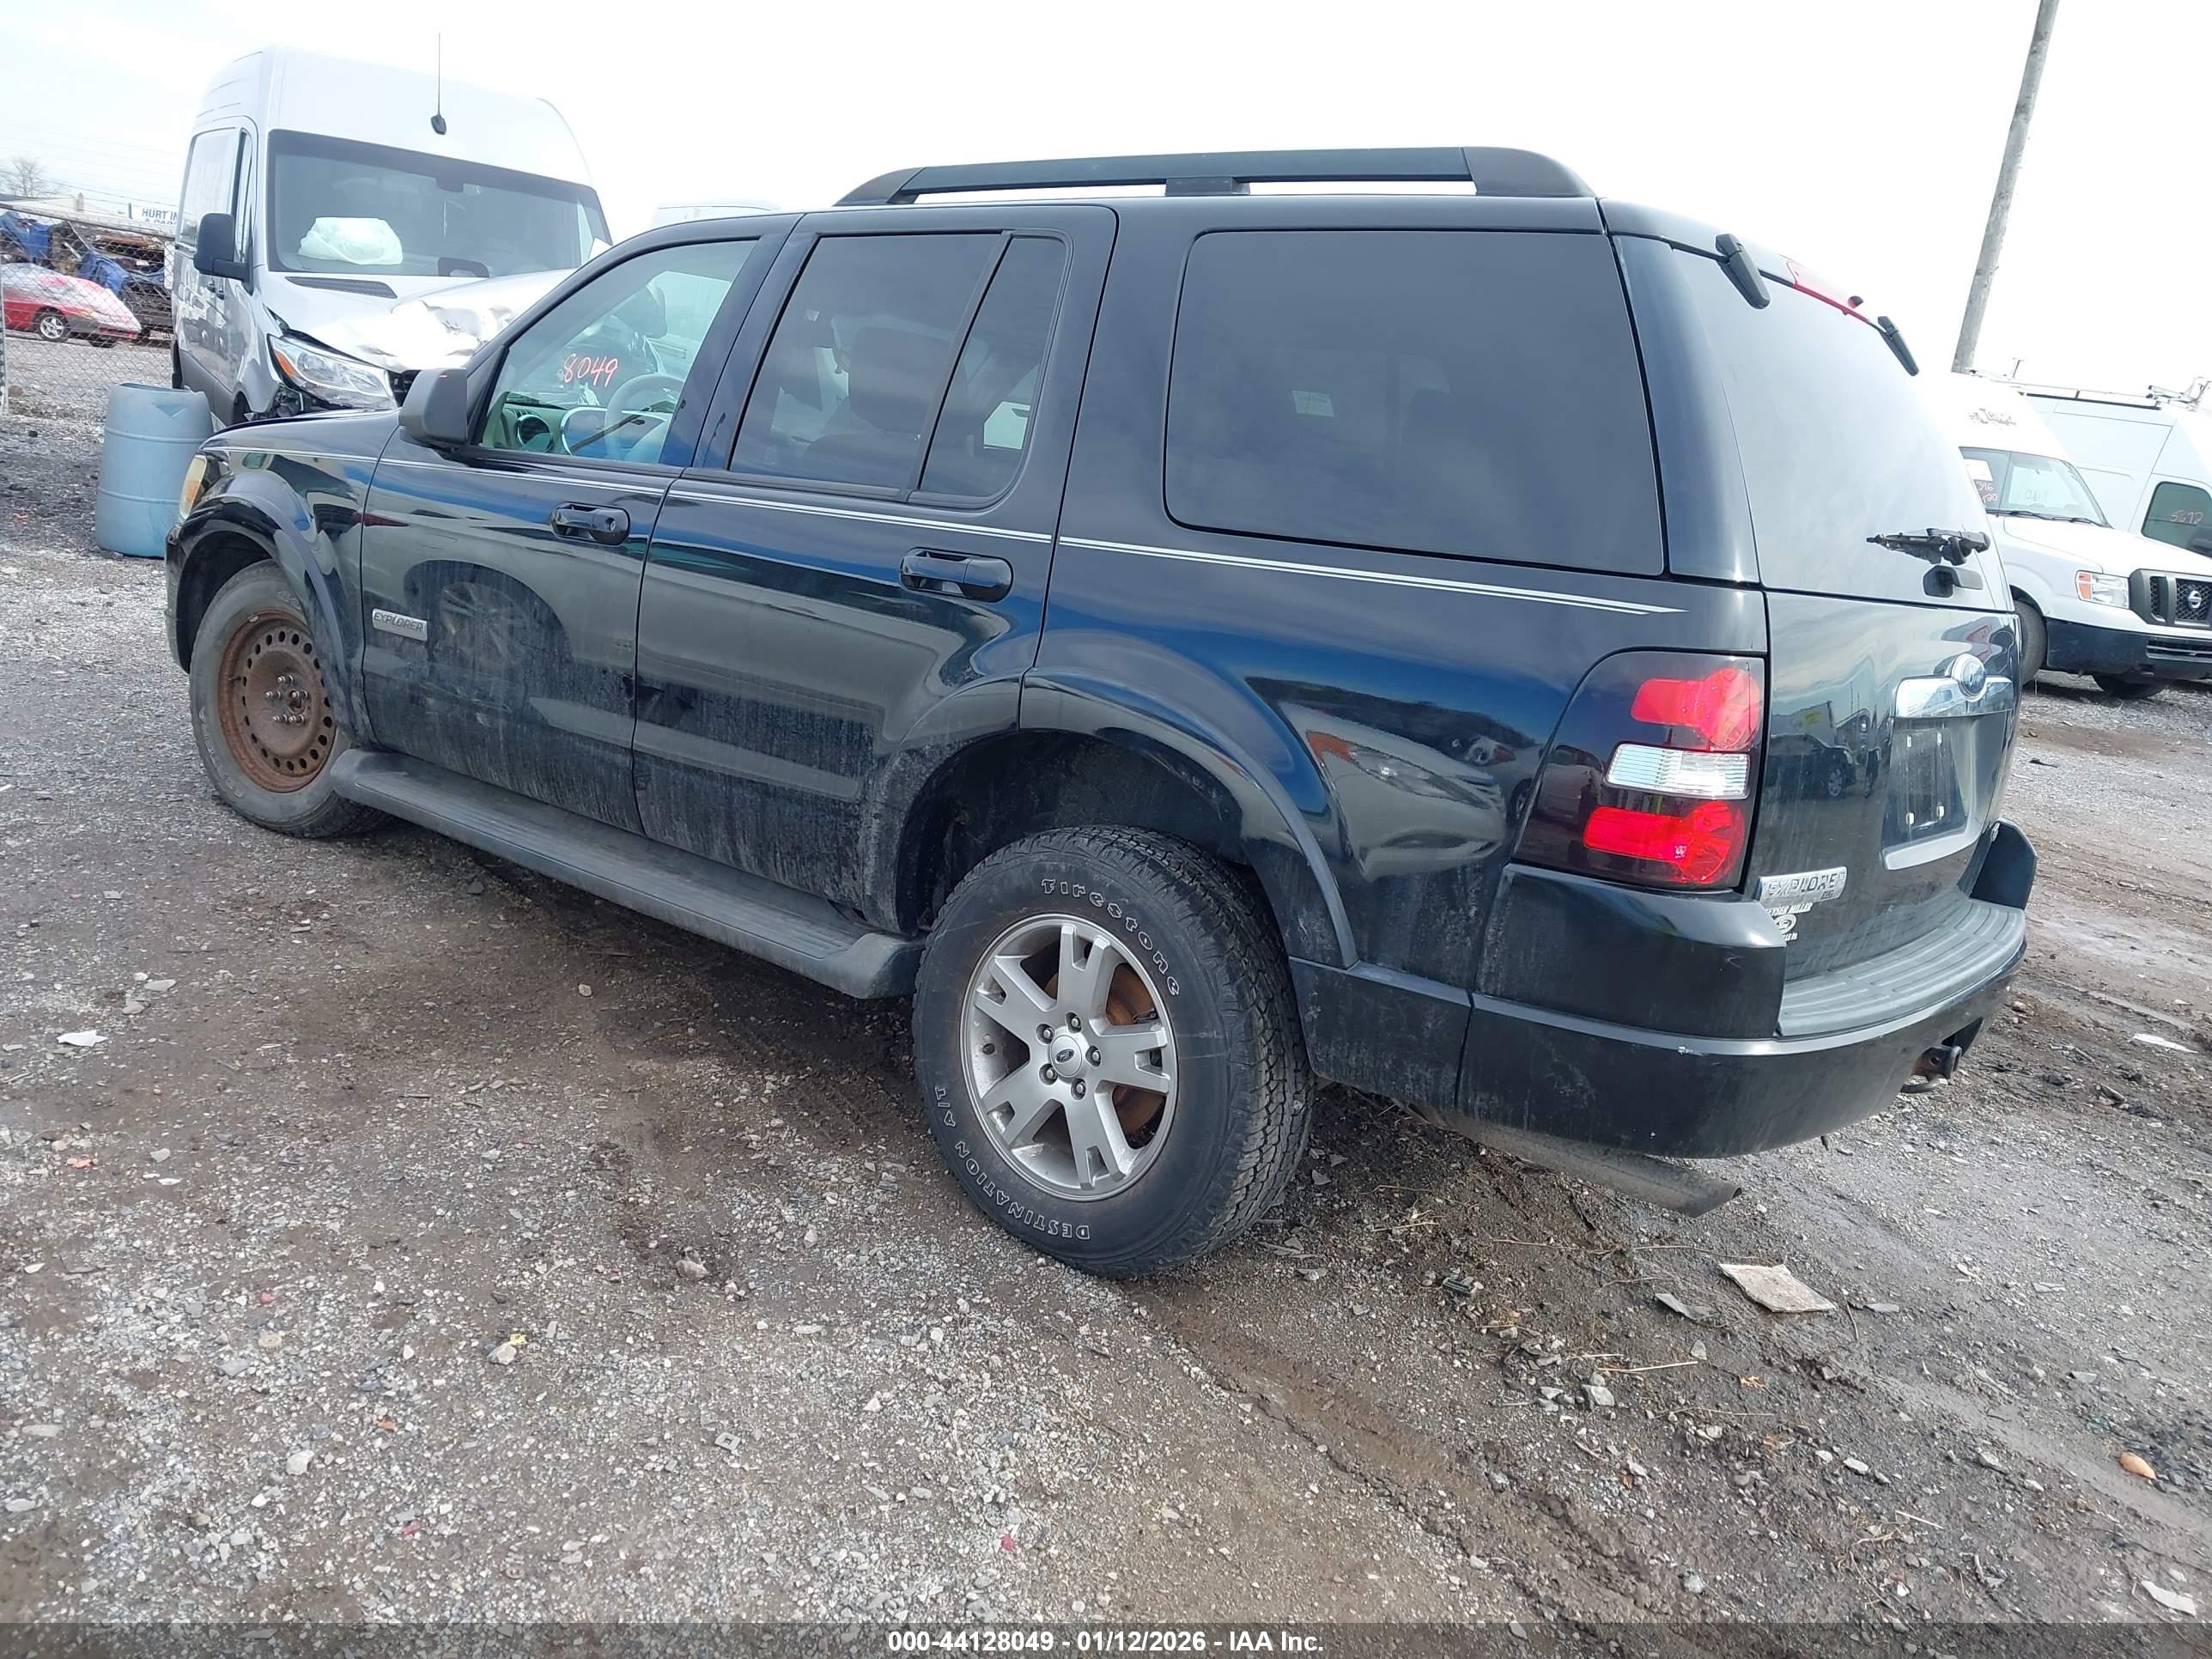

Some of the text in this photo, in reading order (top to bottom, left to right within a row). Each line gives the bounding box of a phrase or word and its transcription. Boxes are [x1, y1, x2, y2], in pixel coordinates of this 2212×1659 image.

[142, 208, 167, 220] HURT
[563, 353, 618, 387] 8049
[374, 611, 424, 633] EXPLORER
[954, 1140, 1091, 1240] DESTINATION
